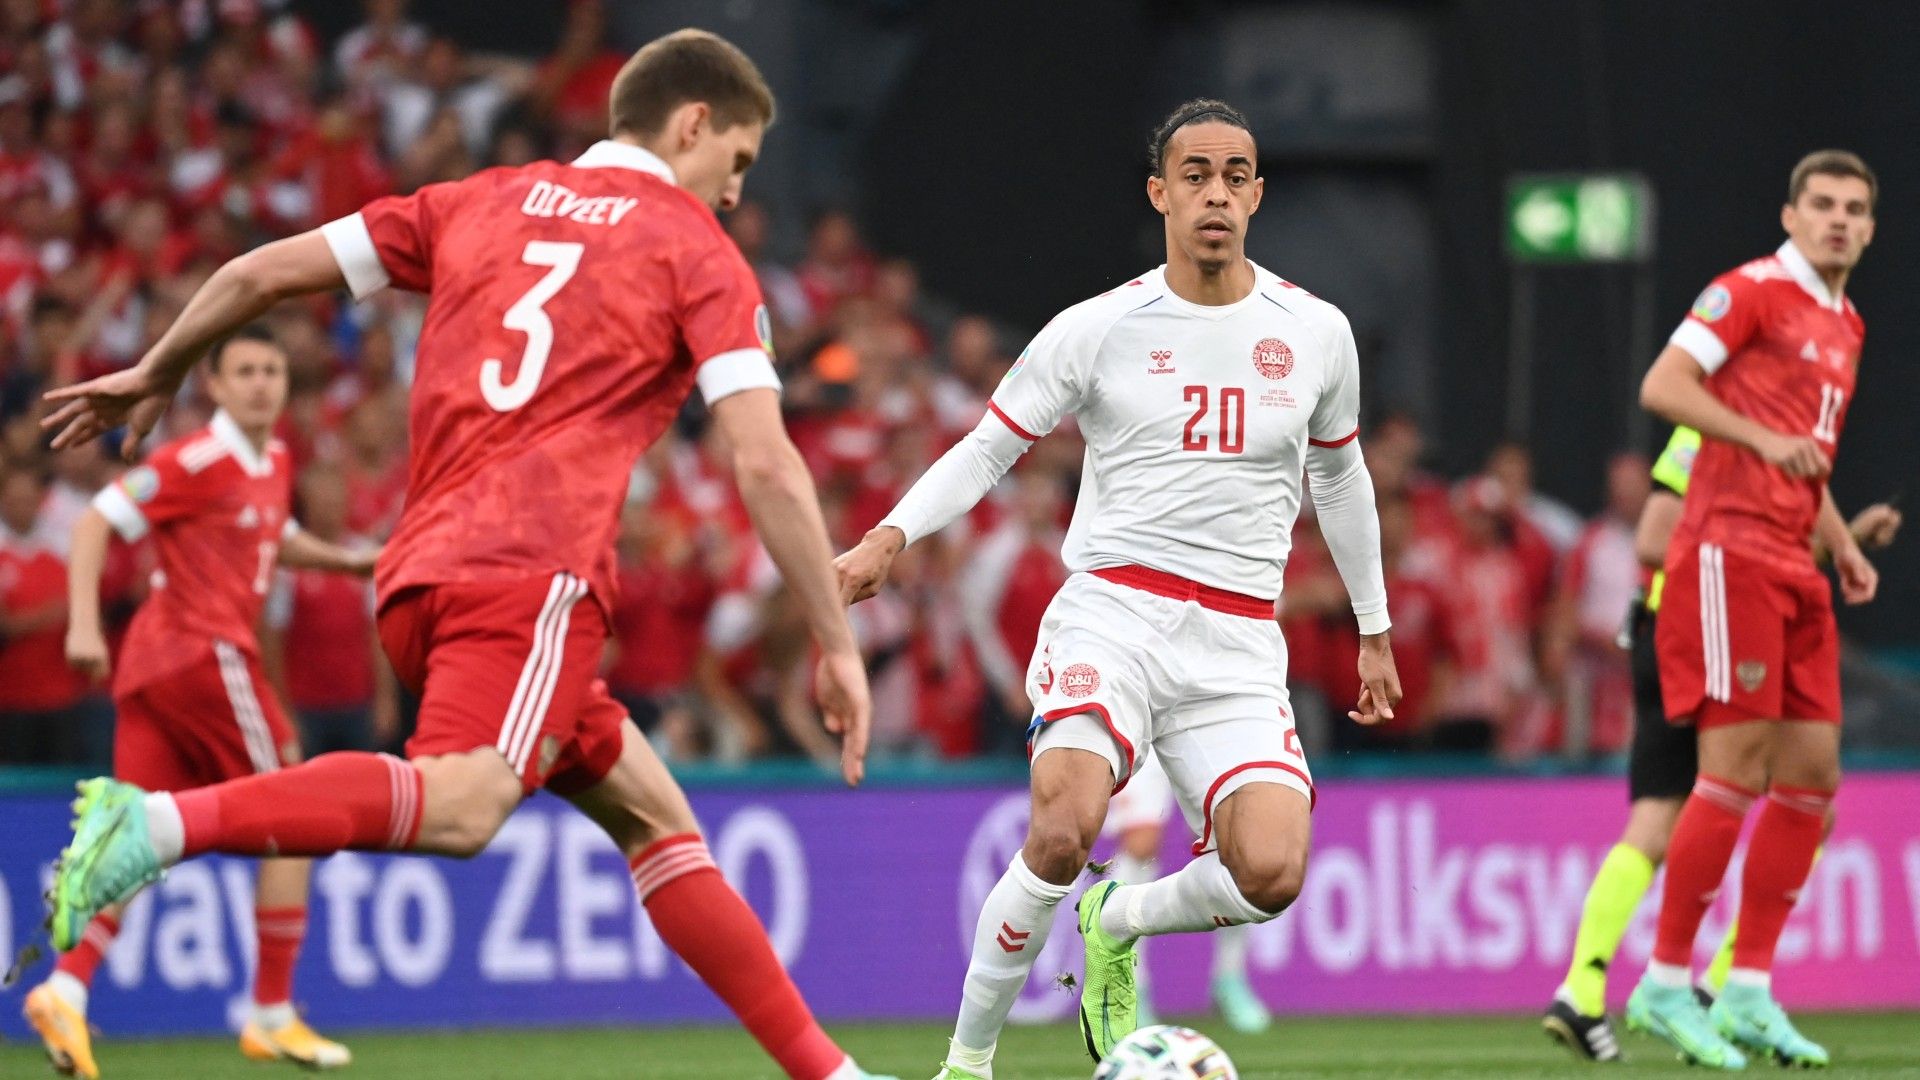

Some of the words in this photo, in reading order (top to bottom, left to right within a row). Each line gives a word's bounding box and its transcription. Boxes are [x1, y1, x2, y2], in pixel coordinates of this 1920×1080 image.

[521, 179, 639, 226] DIVEEV
[479, 239, 585, 412] 3
[1147, 367, 1176, 375] hummel
[1261, 351, 1286, 365] DBU
[1183, 385, 1244, 454] 20
[1067, 674, 1092, 687] DBU
[316, 850, 455, 988] to
[478, 805, 809, 984] ZEO
